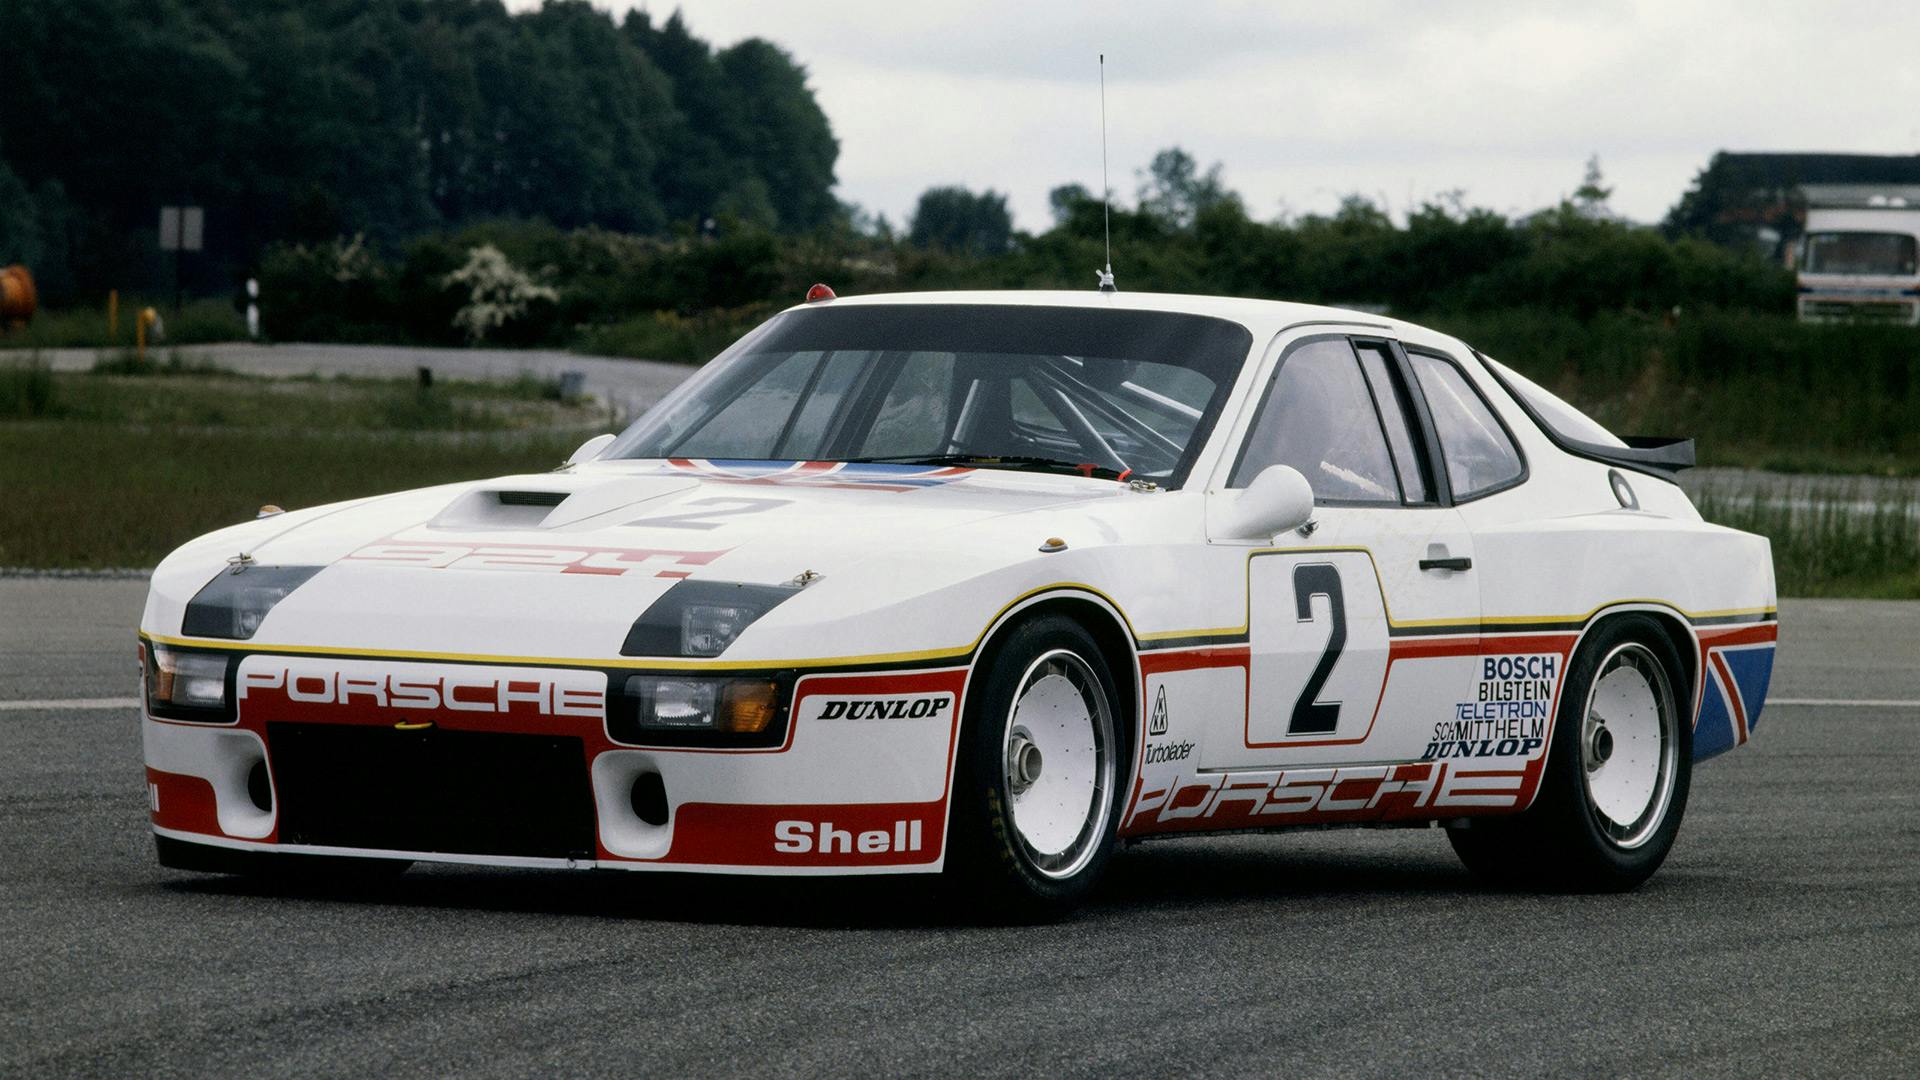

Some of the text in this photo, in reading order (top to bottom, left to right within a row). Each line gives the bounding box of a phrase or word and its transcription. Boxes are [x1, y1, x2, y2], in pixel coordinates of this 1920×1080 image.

[620, 496, 795, 531] 2
[340, 542, 714, 577] 924
[1286, 562, 1347, 737] 2
[1483, 656, 1555, 680] BOSCH
[238, 667, 603, 718] PORSCHE
[1478, 680, 1551, 702] BILSTEIN
[816, 697, 950, 721] DUNLOP
[1455, 700, 1547, 720] TELETRON
[1432, 719, 1545, 741] SCHMITTHELM
[1144, 739, 1196, 765] Turbolader
[1420, 738, 1543, 760] DUNLOP
[1126, 764, 1526, 828] PORSCHE
[773, 819, 923, 853] Shell
